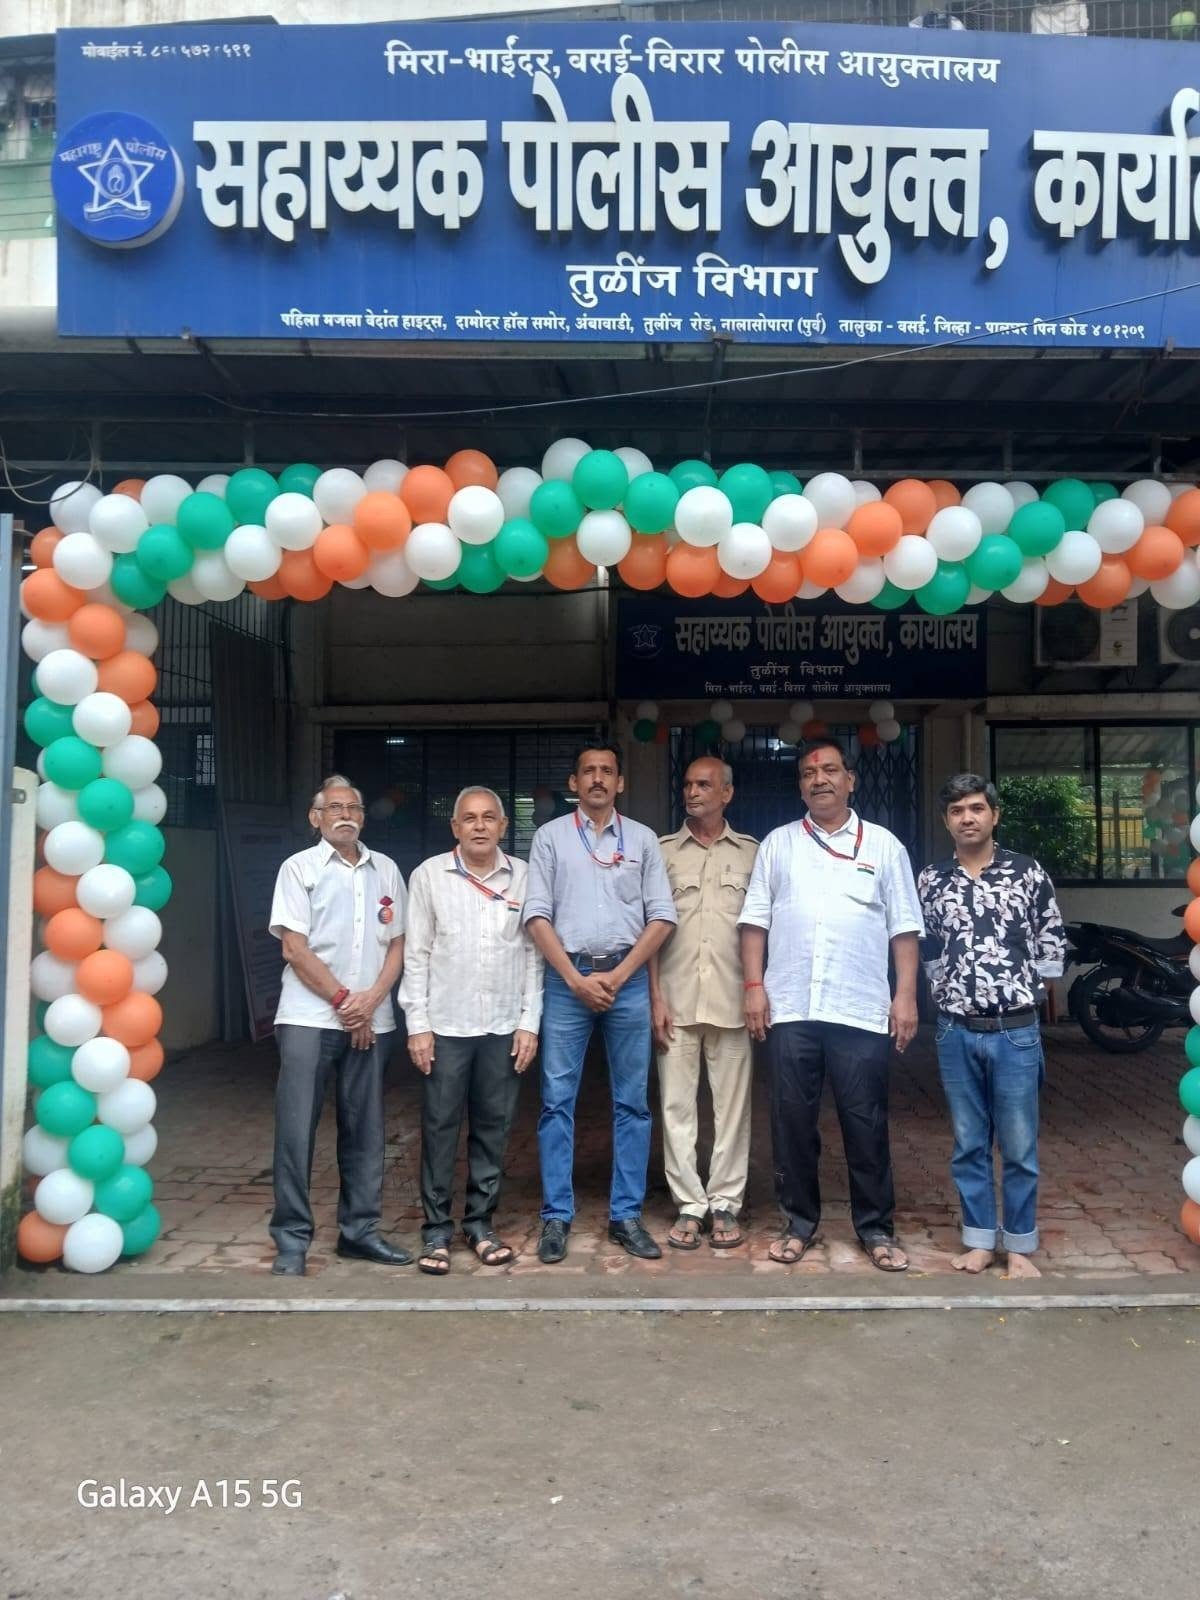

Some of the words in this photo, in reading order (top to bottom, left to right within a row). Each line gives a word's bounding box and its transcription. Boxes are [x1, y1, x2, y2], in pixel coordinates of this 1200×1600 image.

[734, 37, 829, 75] पोलीस
[837, 51, 1001, 88] आयुक्तालय
[125, 137, 168, 160] पोलीस
[193, 120, 487, 242] सहाय्यक
[502, 71, 730, 231] पोलीस
[745, 120, 1009, 284] आयुक्त,
[1033, 87, 1200, 240] कार्या
[565, 251, 682, 308] तुळींज
[692, 252, 819, 298] विभाग
[280, 308, 320, 328] पहिला
[323, 313, 362, 328] मजला
[364, 309, 399, 329] वेदांत
[455, 310, 500, 330] दामोदर
[503, 311, 528, 330] हॉल
[531, 311, 571, 333] समोर,
[575, 312, 634, 334] अंबावाडी,
[690, 312, 716, 333] रोड,
[721, 312, 793, 332] नालासोपारा
[798, 313, 827, 336] (पुर्व)
[839, 318, 883, 338] तालुका
[934, 316, 970, 335] जिल्हा
[1033, 317, 1057, 336] पिन
[1060, 317, 1088, 336] कोड
[675, 616, 752, 656] सहाय्यक
[756, 604, 816, 651] पोलीस
[820, 614, 893, 665] आयुक्त,
[800, 661, 844, 677] विभाग
